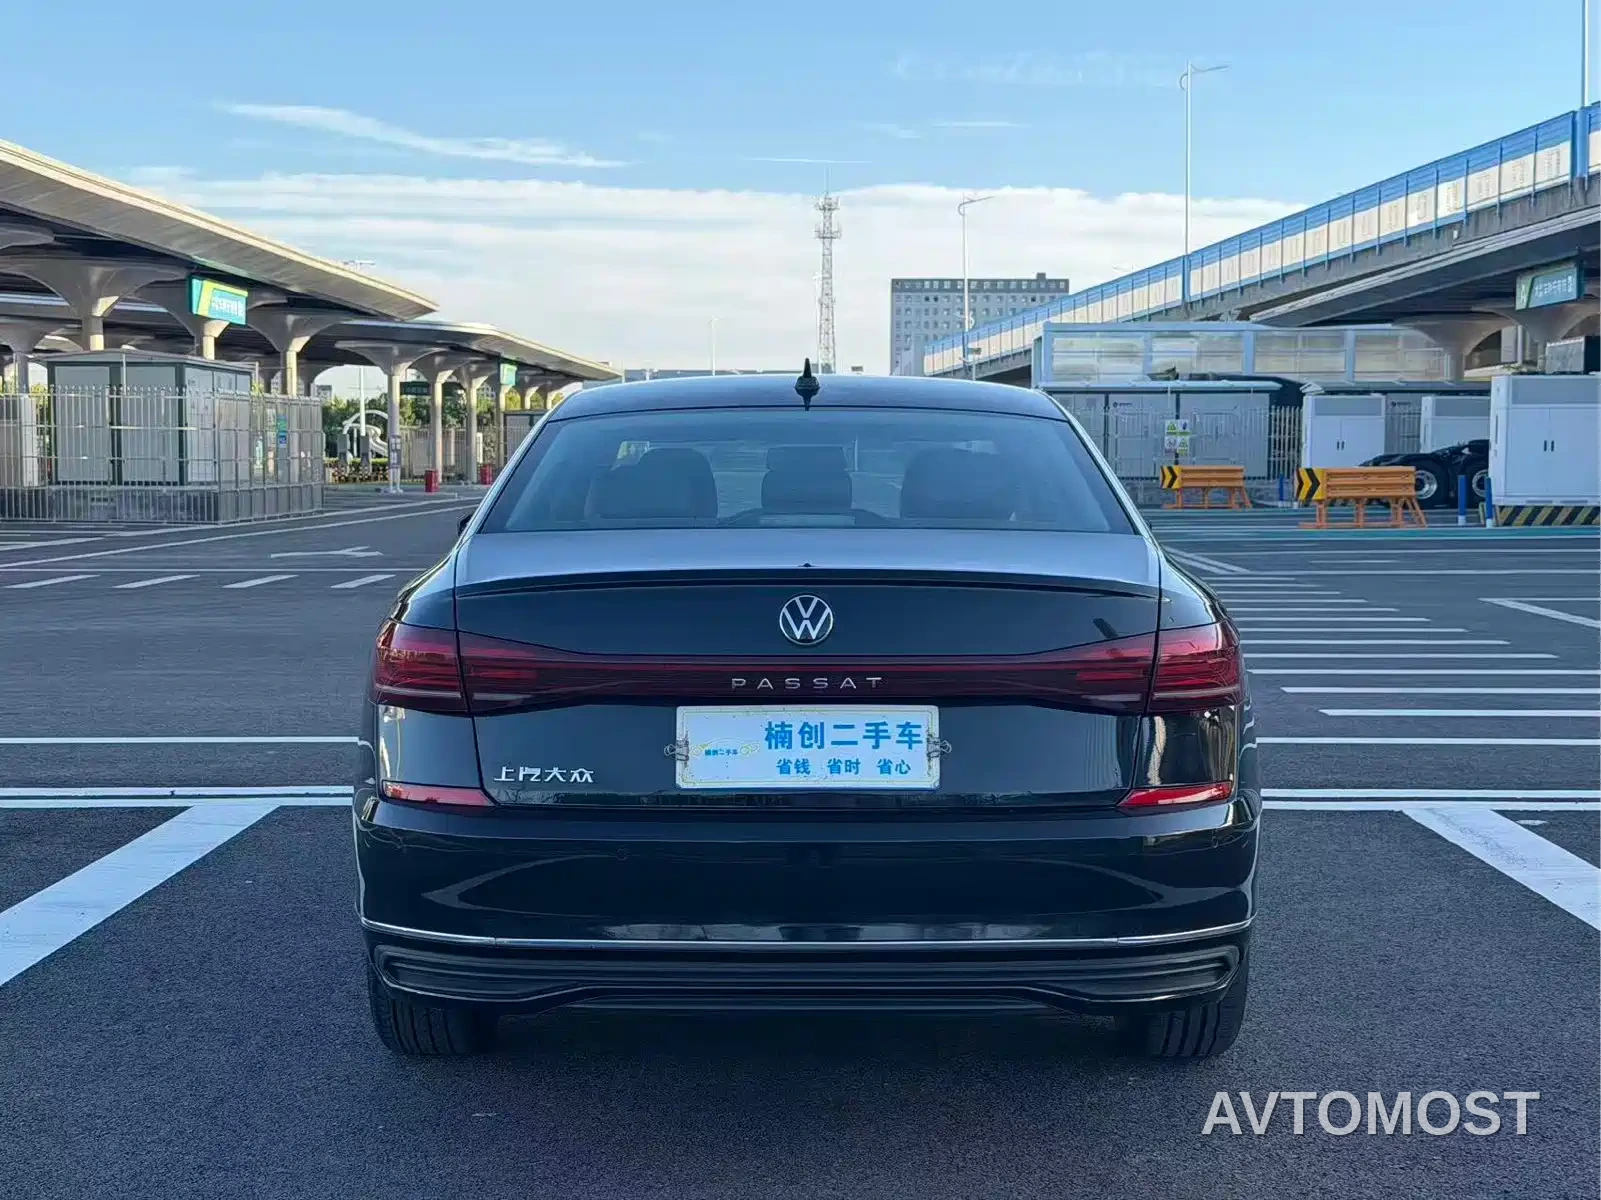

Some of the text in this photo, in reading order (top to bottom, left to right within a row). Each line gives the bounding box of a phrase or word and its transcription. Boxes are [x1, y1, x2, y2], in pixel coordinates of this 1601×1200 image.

[731, 677, 882, 690] PASSAT
[764, 721, 923, 750] 楠创二手车
[776, 758, 911, 775] 省钱 省时 省心
